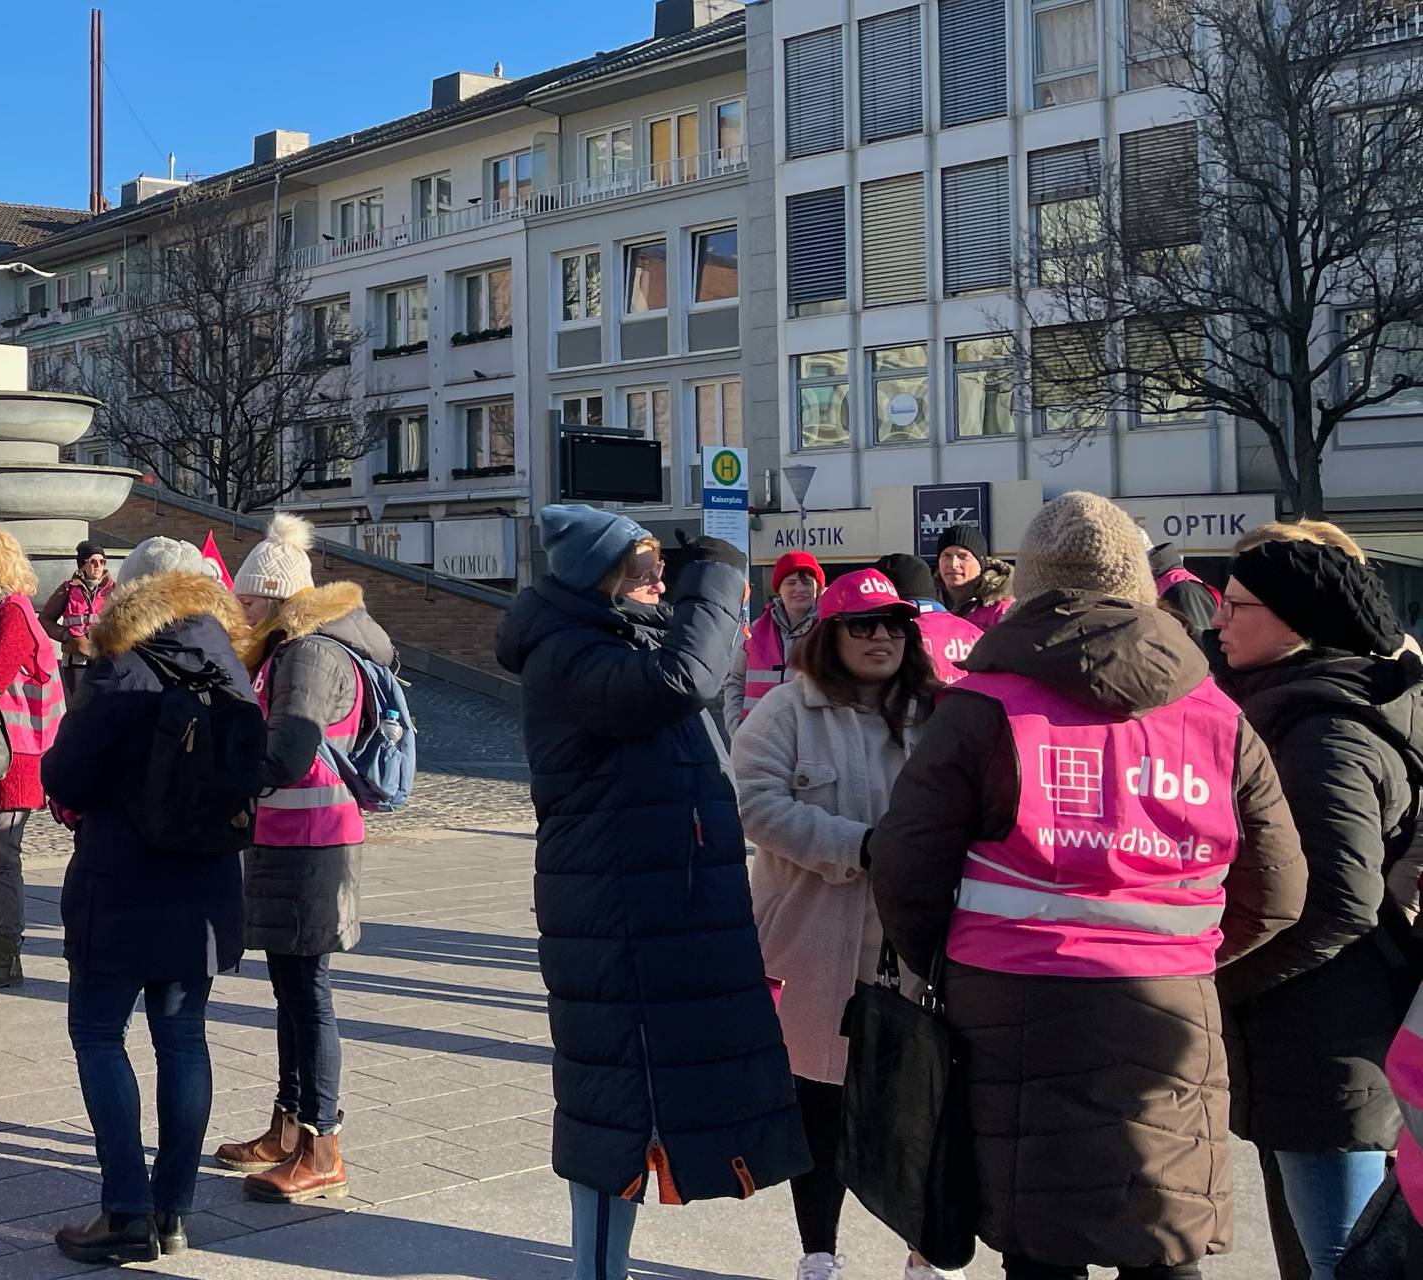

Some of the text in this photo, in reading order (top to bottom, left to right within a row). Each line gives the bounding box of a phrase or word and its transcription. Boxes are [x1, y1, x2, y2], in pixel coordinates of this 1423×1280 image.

[711, 494, 743, 505] Kaiserplatz
[1162, 512, 1246, 537] OPTIK
[774, 525, 845, 548] AKUSTIK
[859, 576, 899, 598] dbb
[944, 638, 976, 661] db
[1124, 755, 1211, 806] dbb
[1037, 825, 1213, 863] www.dbb.de
